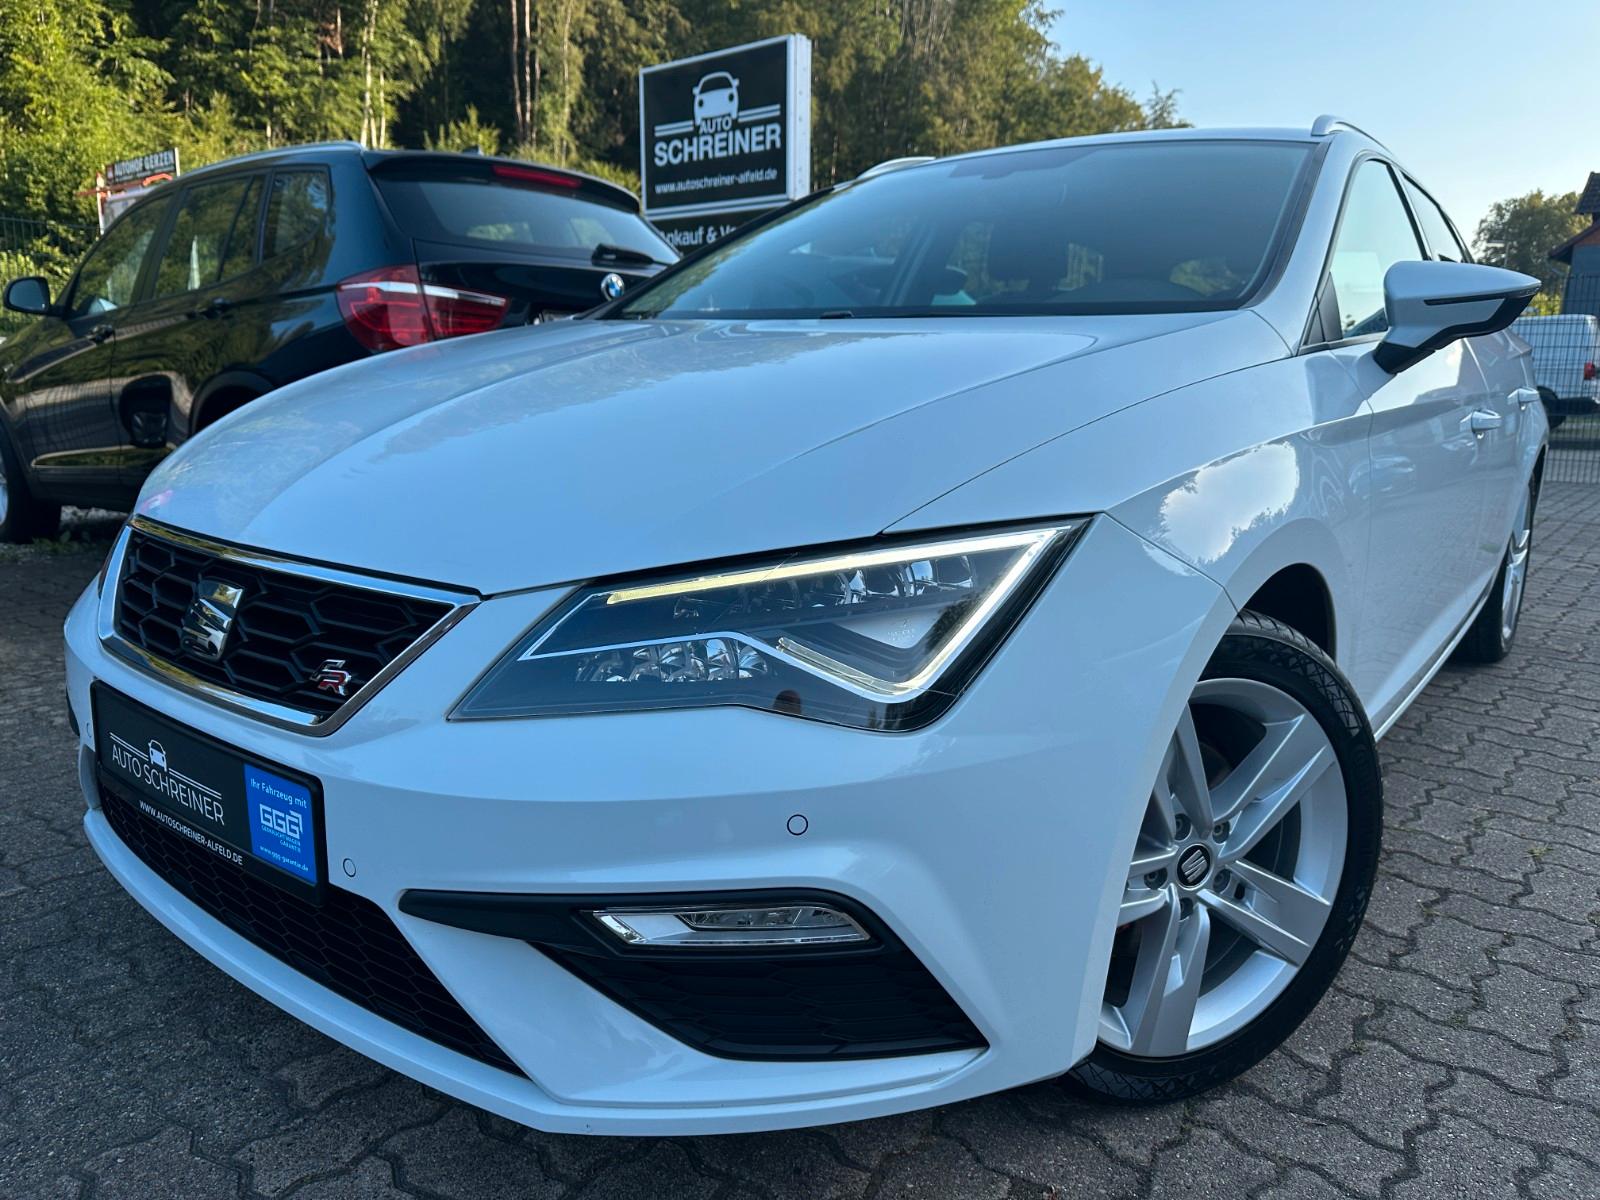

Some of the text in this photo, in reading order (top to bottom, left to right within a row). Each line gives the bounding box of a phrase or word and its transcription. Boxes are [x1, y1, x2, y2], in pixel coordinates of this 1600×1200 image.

[699, 116, 732, 134] AUTO
[654, 123, 781, 166] SCHREINER
[655, 168, 777, 194] www.autoschreiner-alfeld.de
[706, 225, 718, 244] &
[112, 744, 225, 826] AUTO SCHREINER
[250, 778, 307, 809] Ihr Fahrzeug mit
[139, 800, 243, 866] WWW.AUTOSCHREINER-ALFELD.DE
